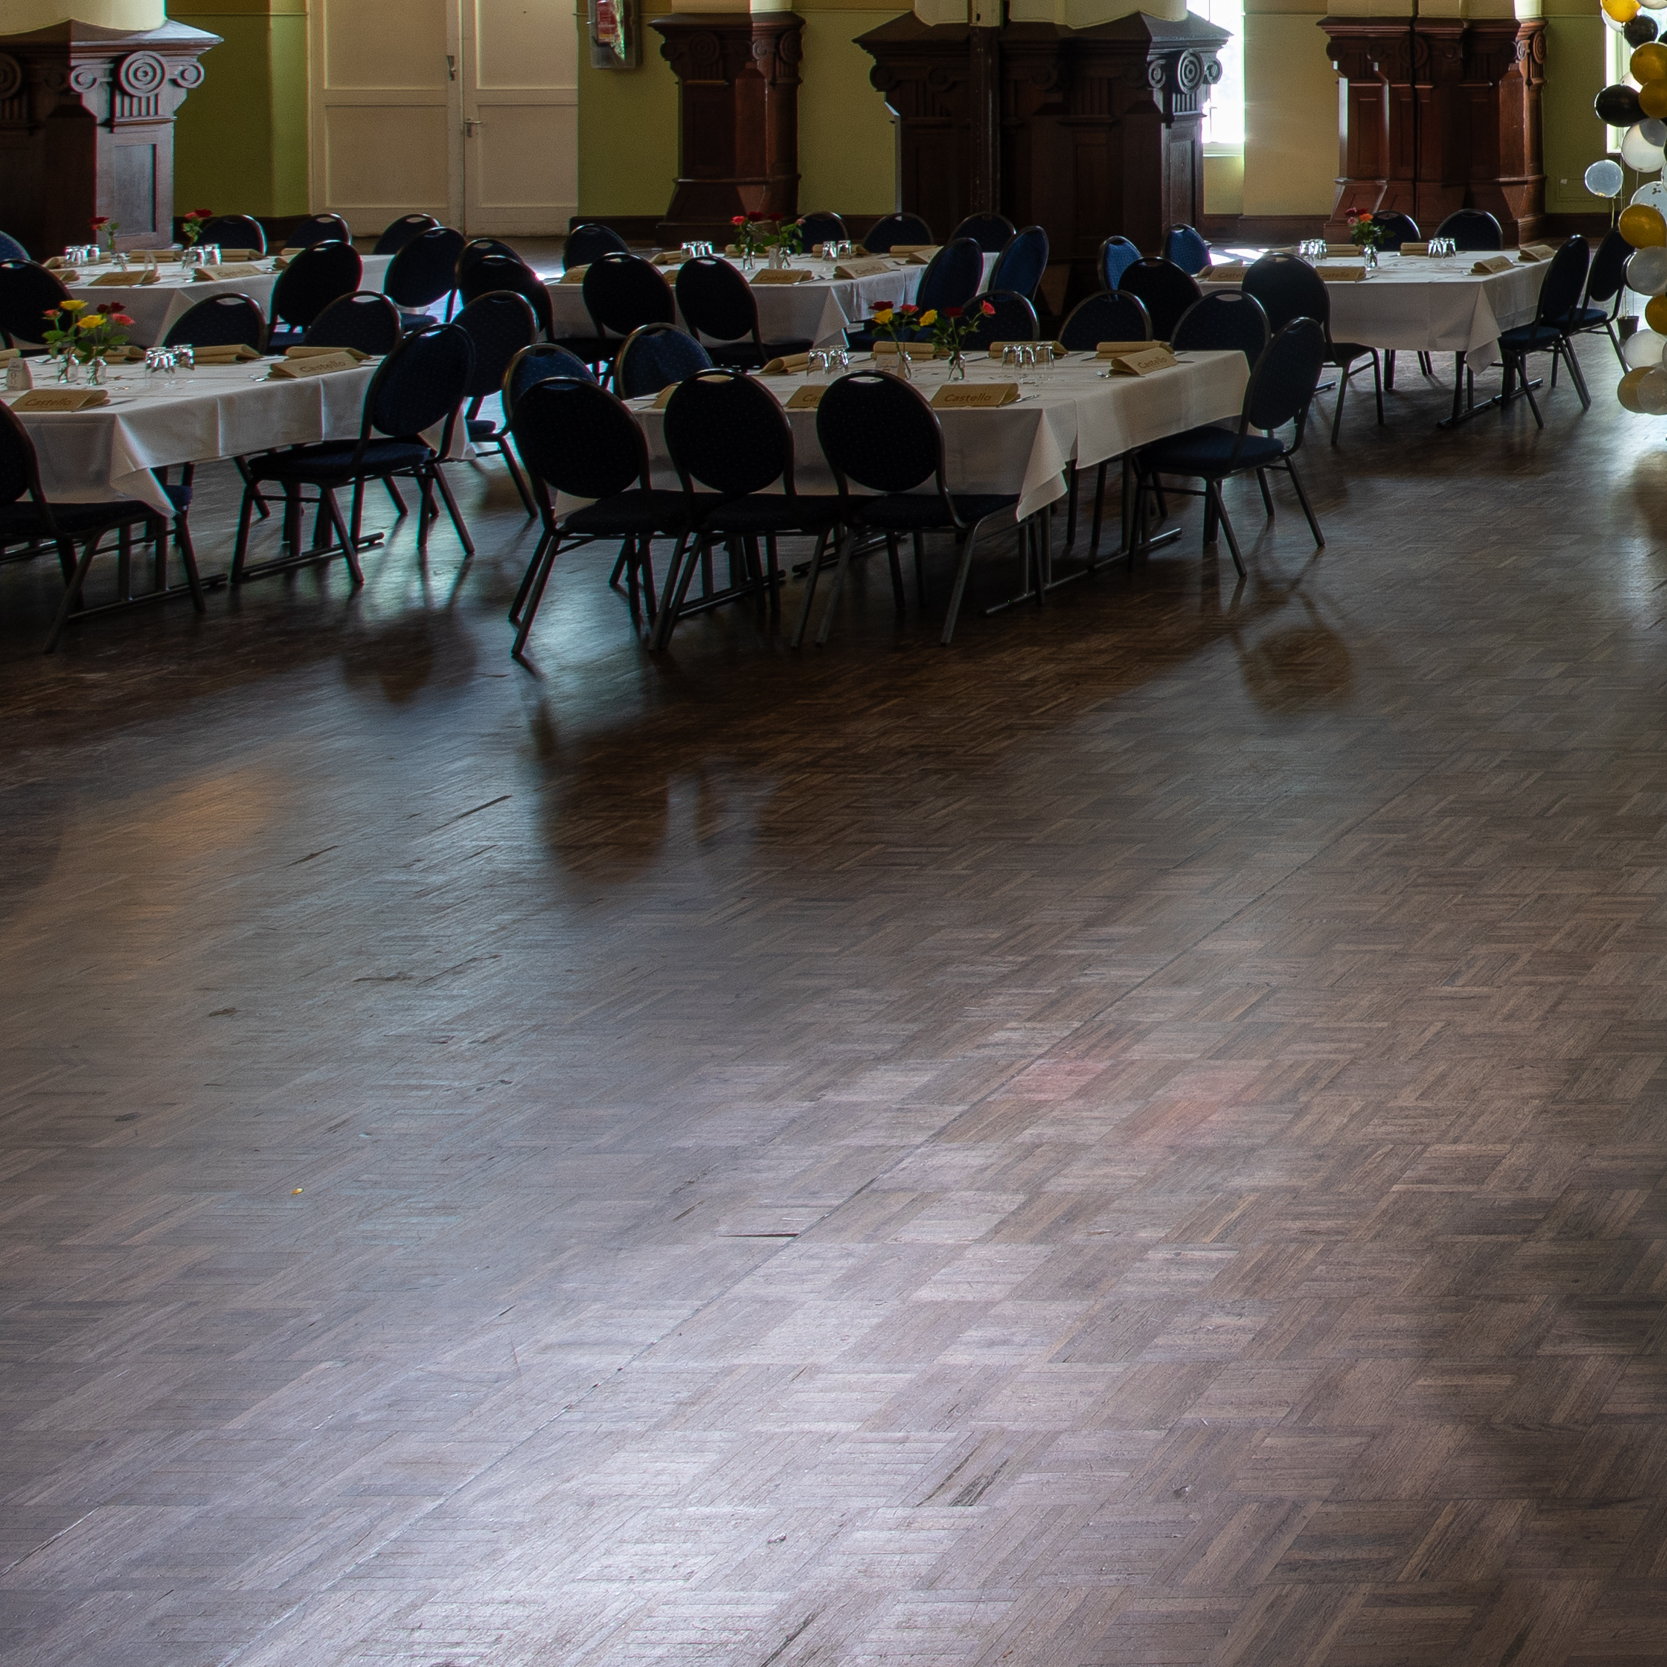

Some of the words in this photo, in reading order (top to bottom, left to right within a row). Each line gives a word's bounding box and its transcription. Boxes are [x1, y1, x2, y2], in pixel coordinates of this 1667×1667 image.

[1218, 271, 1246, 279] Castel
[299, 358, 346, 374] Castello
[1137, 356, 1168, 370] Castello
[24, 397, 72, 408] Castello
[944, 392, 992, 403] Castello
